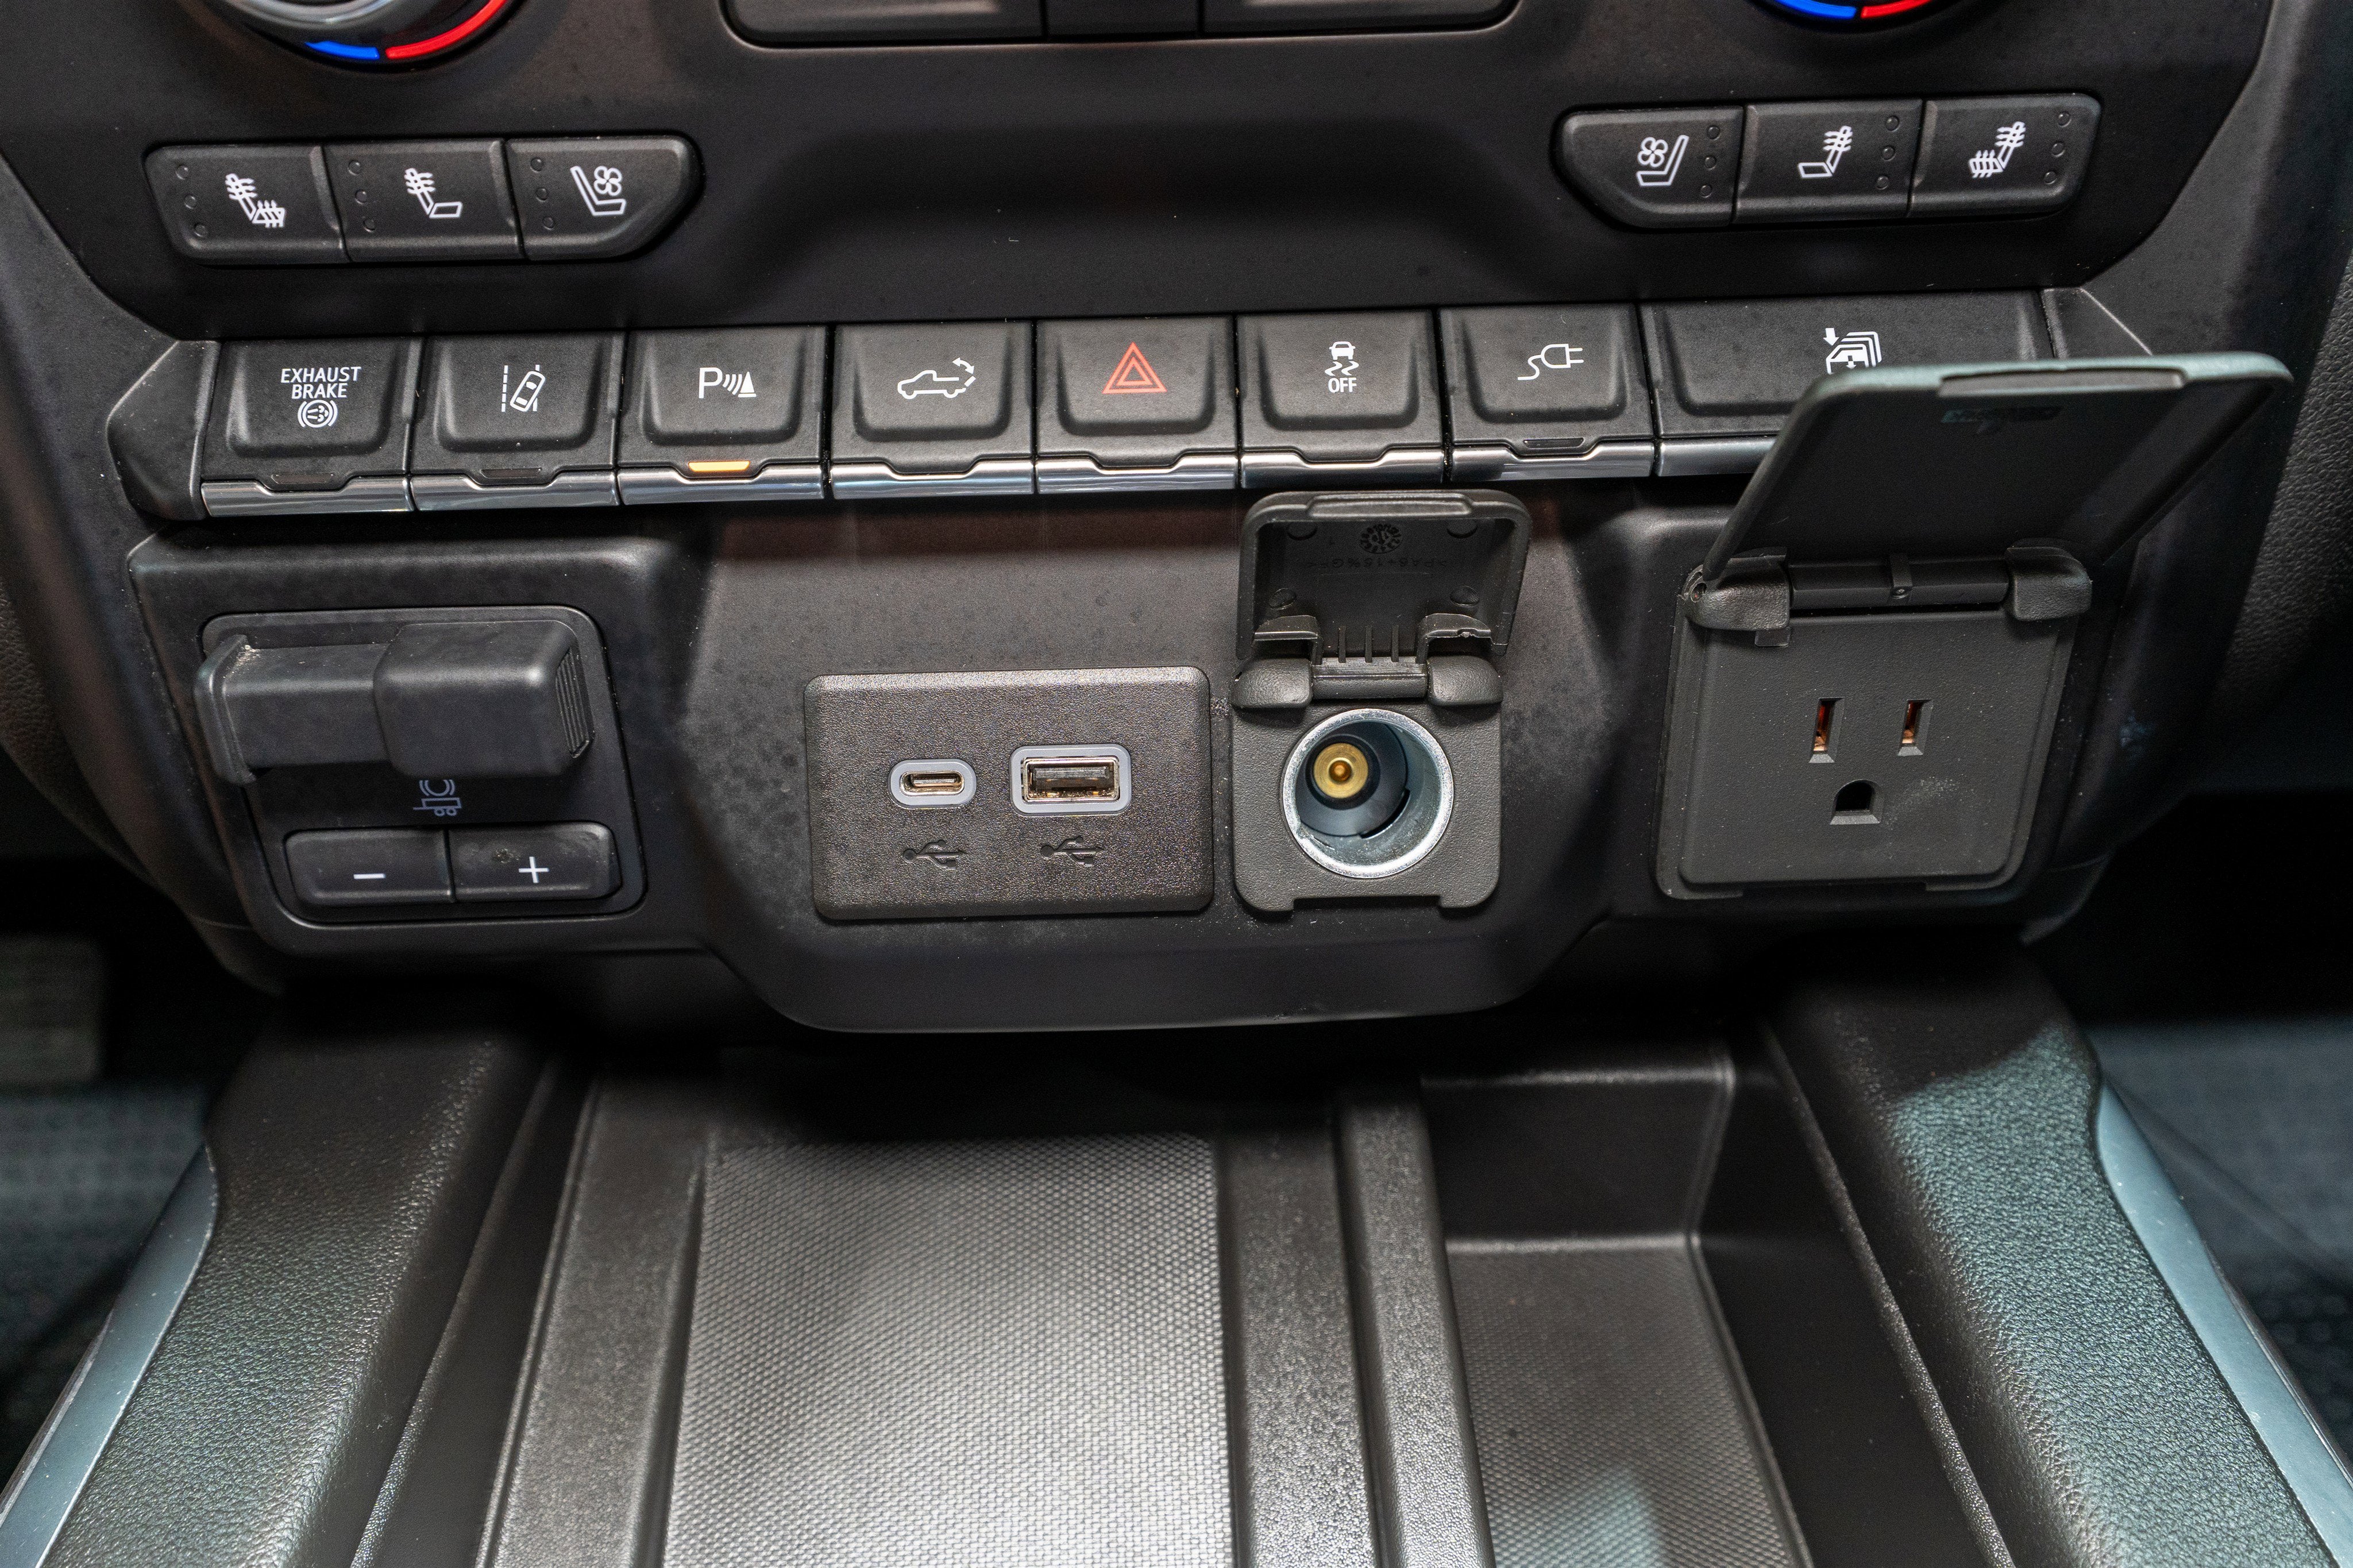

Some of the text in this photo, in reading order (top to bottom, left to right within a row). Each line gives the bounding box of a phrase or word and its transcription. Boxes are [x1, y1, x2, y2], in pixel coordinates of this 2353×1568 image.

[280, 366, 362, 383] EXHAUST
[291, 383, 348, 399] BRAKE
[1328, 377, 1357, 393] OFF
